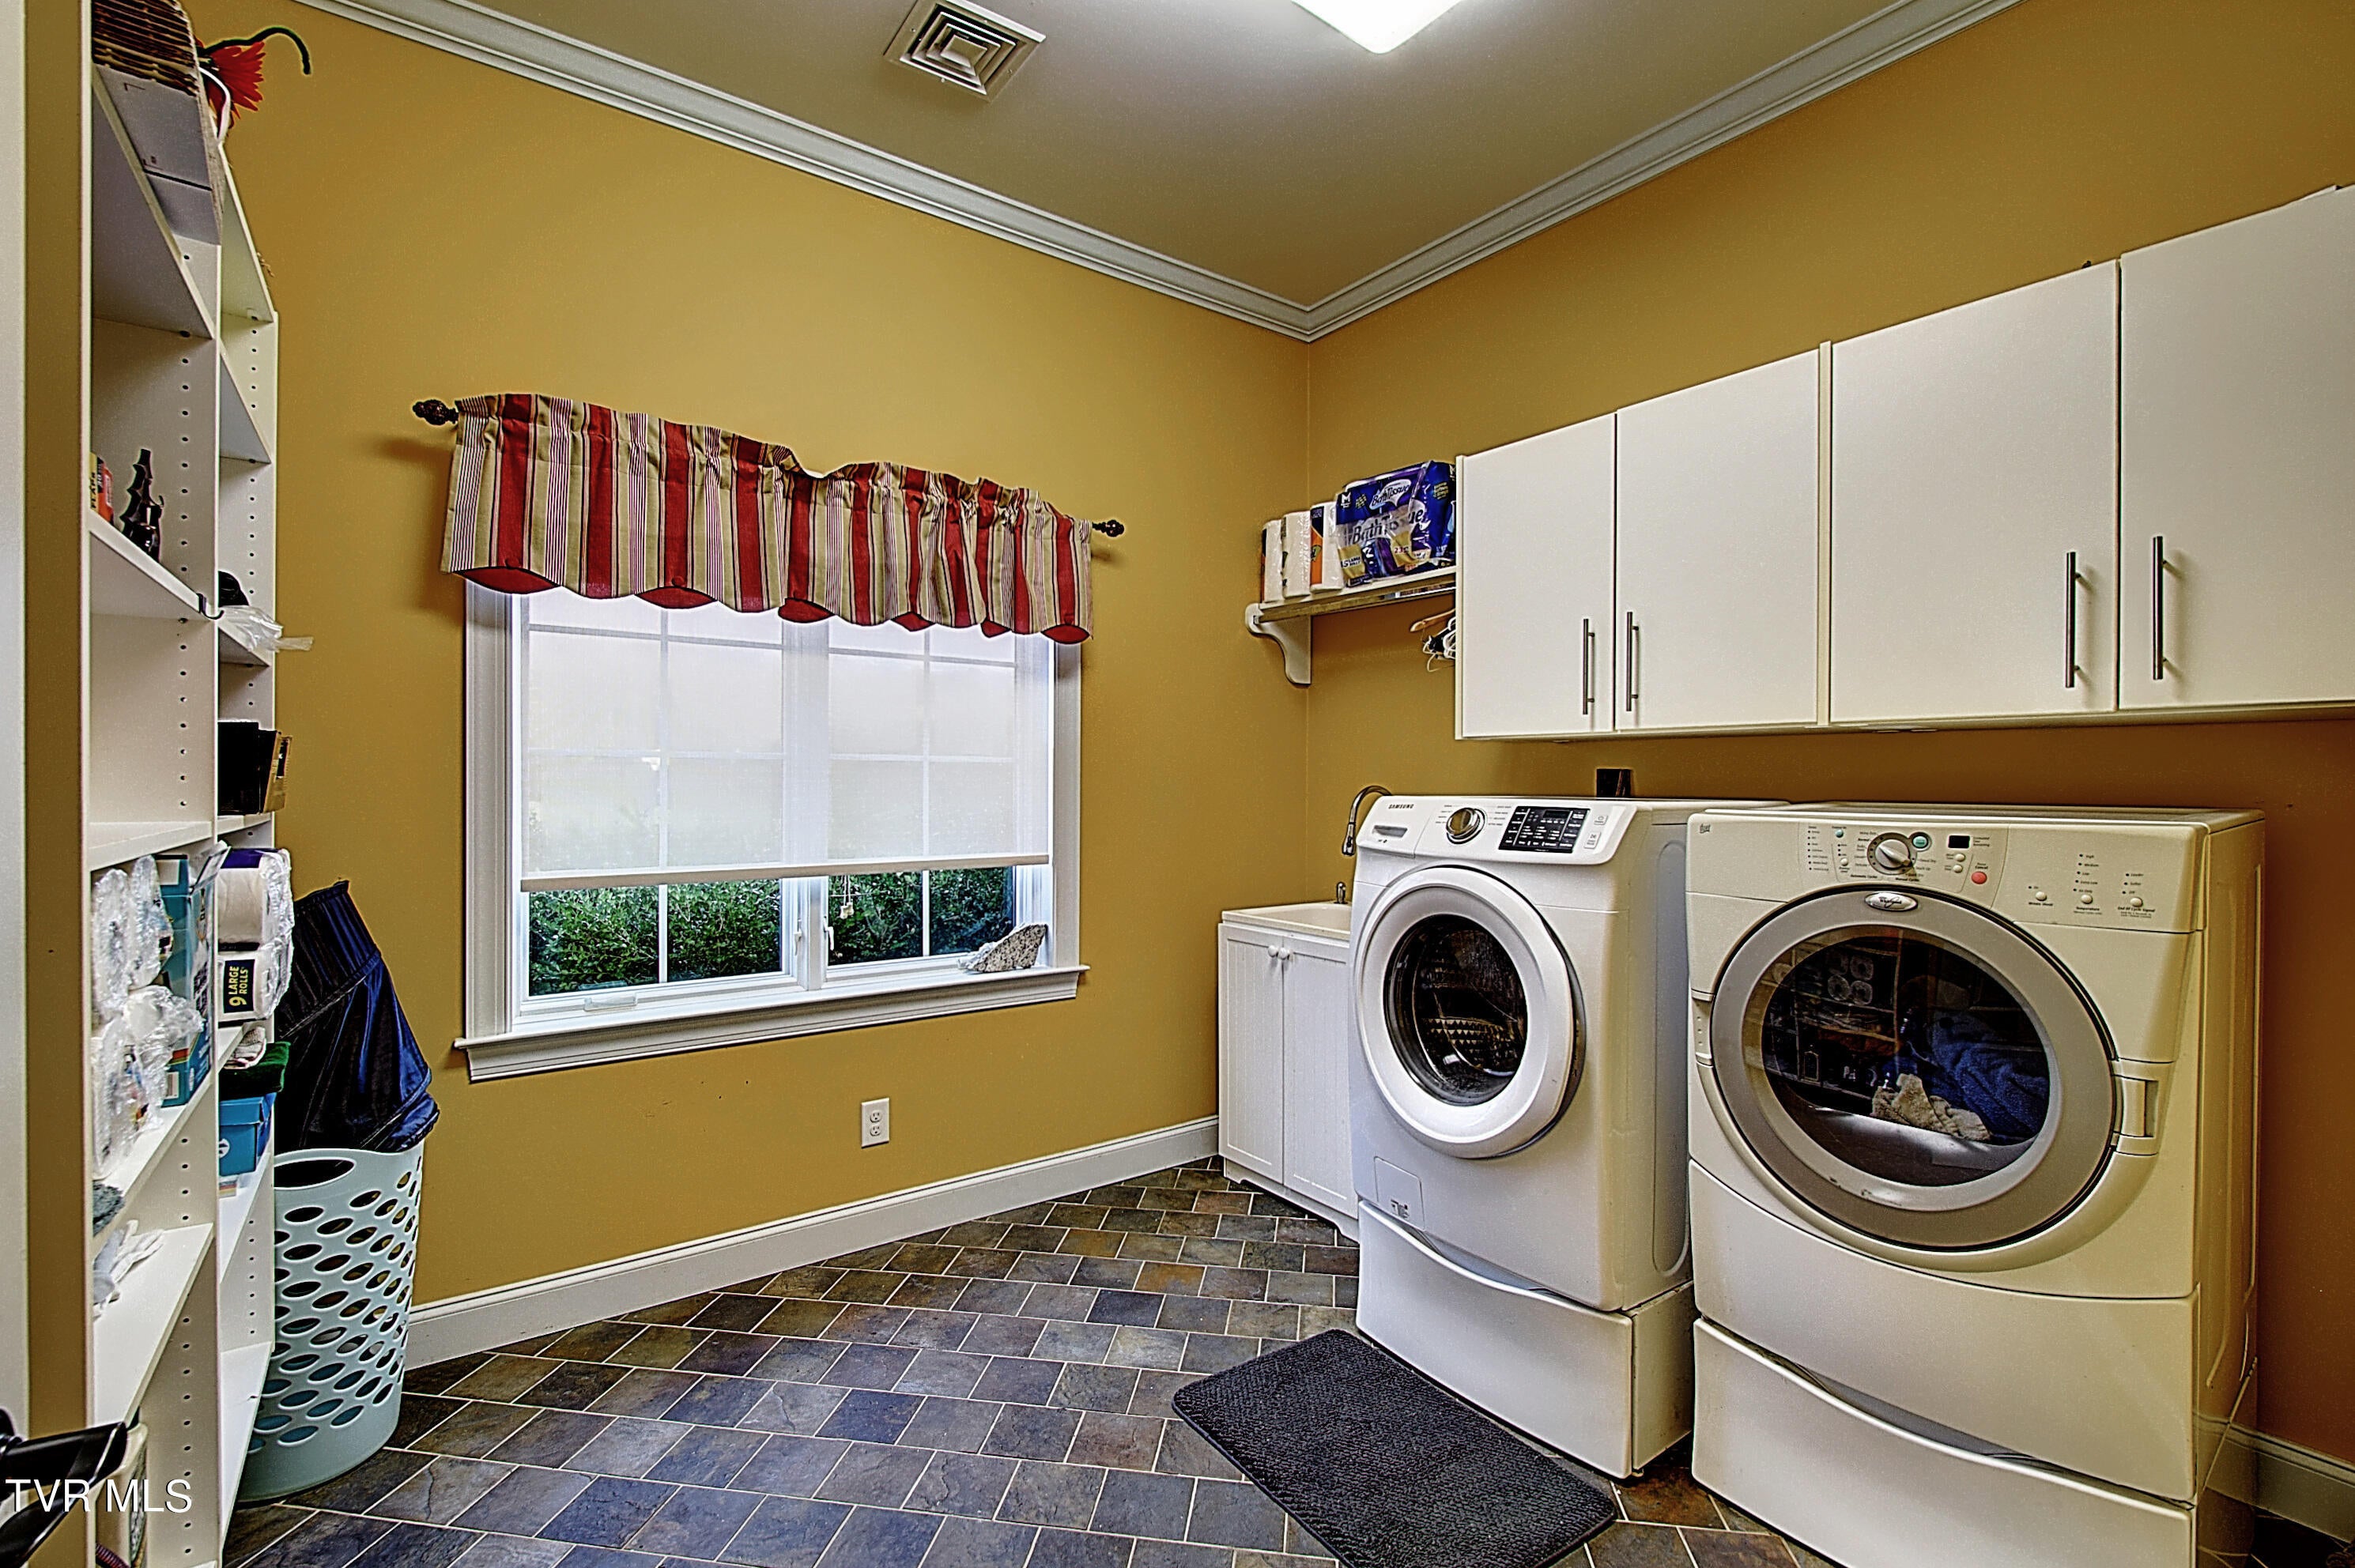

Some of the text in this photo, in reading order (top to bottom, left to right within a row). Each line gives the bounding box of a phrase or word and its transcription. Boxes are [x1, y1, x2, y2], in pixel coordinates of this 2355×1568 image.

[228, 966, 247, 1007] 9 LARGE
[239, 968, 248, 994] ROLLS
